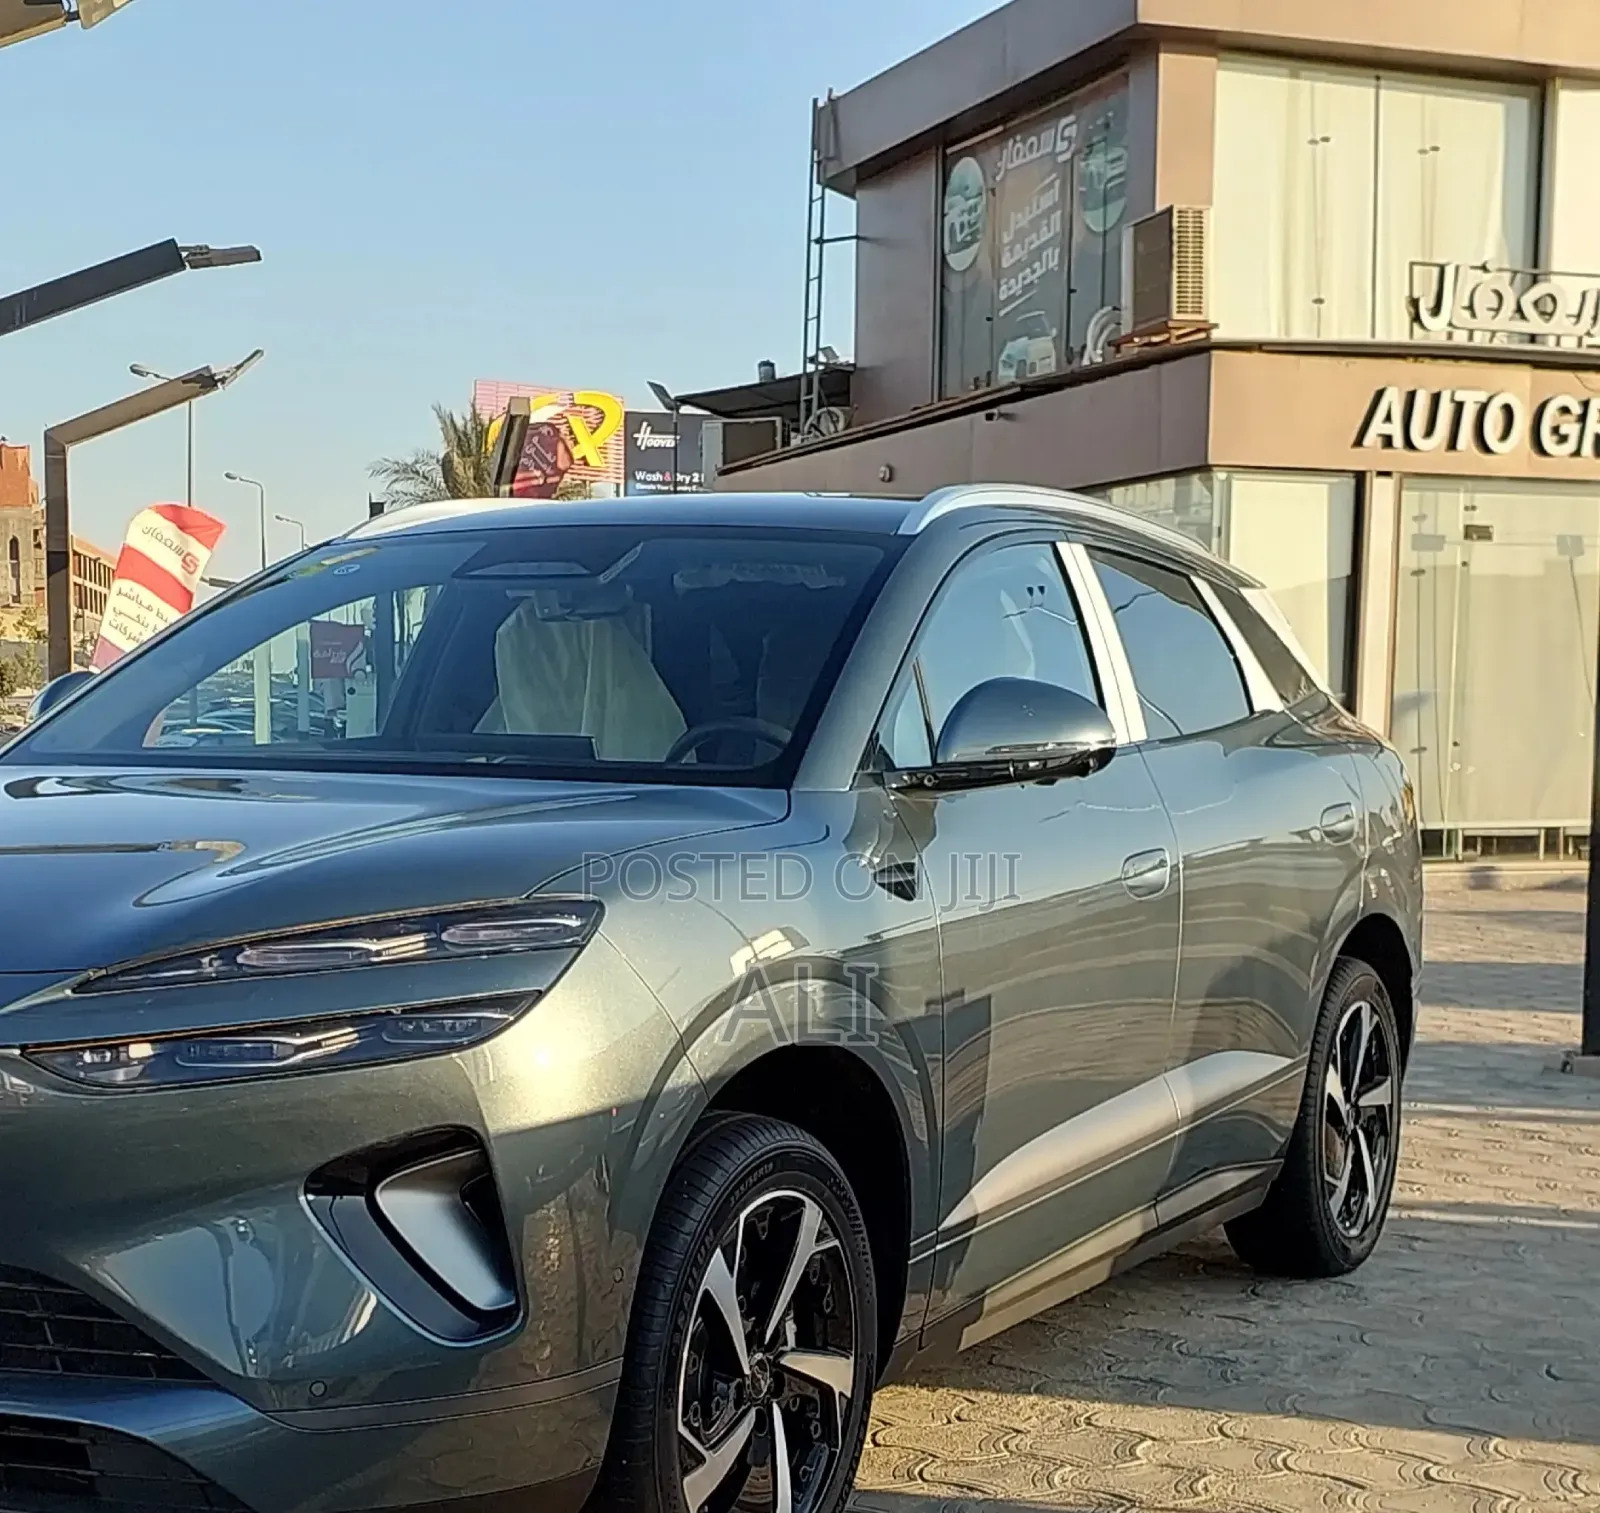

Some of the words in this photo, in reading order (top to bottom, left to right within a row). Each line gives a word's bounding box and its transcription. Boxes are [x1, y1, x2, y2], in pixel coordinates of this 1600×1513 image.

[1002, 210, 1061, 269] القديمة
[999, 247, 1059, 301] بالجديدة
[1355, 385, 1524, 455] AUTO
[635, 470, 662, 482] Wash
[664, 471, 672, 482] &
[115, 586, 153, 613] مباشر
